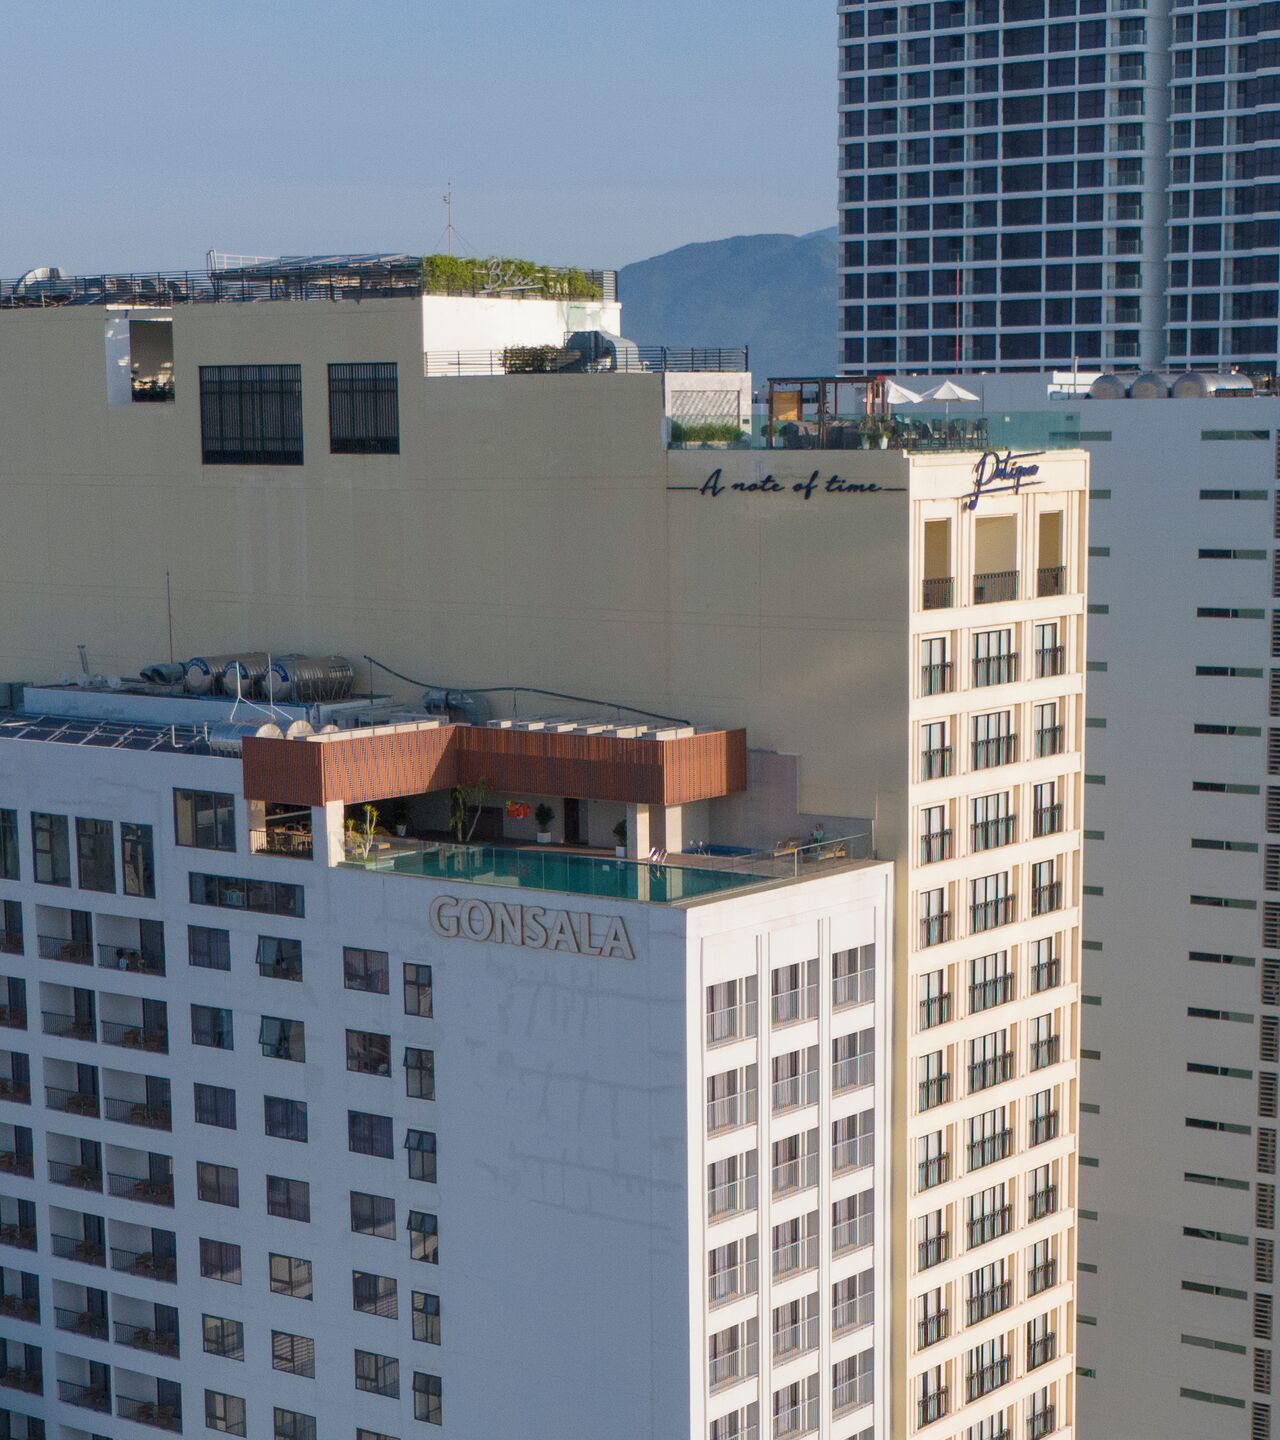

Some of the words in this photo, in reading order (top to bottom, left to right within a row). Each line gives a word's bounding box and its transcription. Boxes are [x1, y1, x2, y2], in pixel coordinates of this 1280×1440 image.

[698, 468, 725, 497] A
[731, 474, 785, 493] note
[793, 470, 818, 499] of
[824, 473, 882, 493] time
[428, 894, 636, 960] GONSALA
